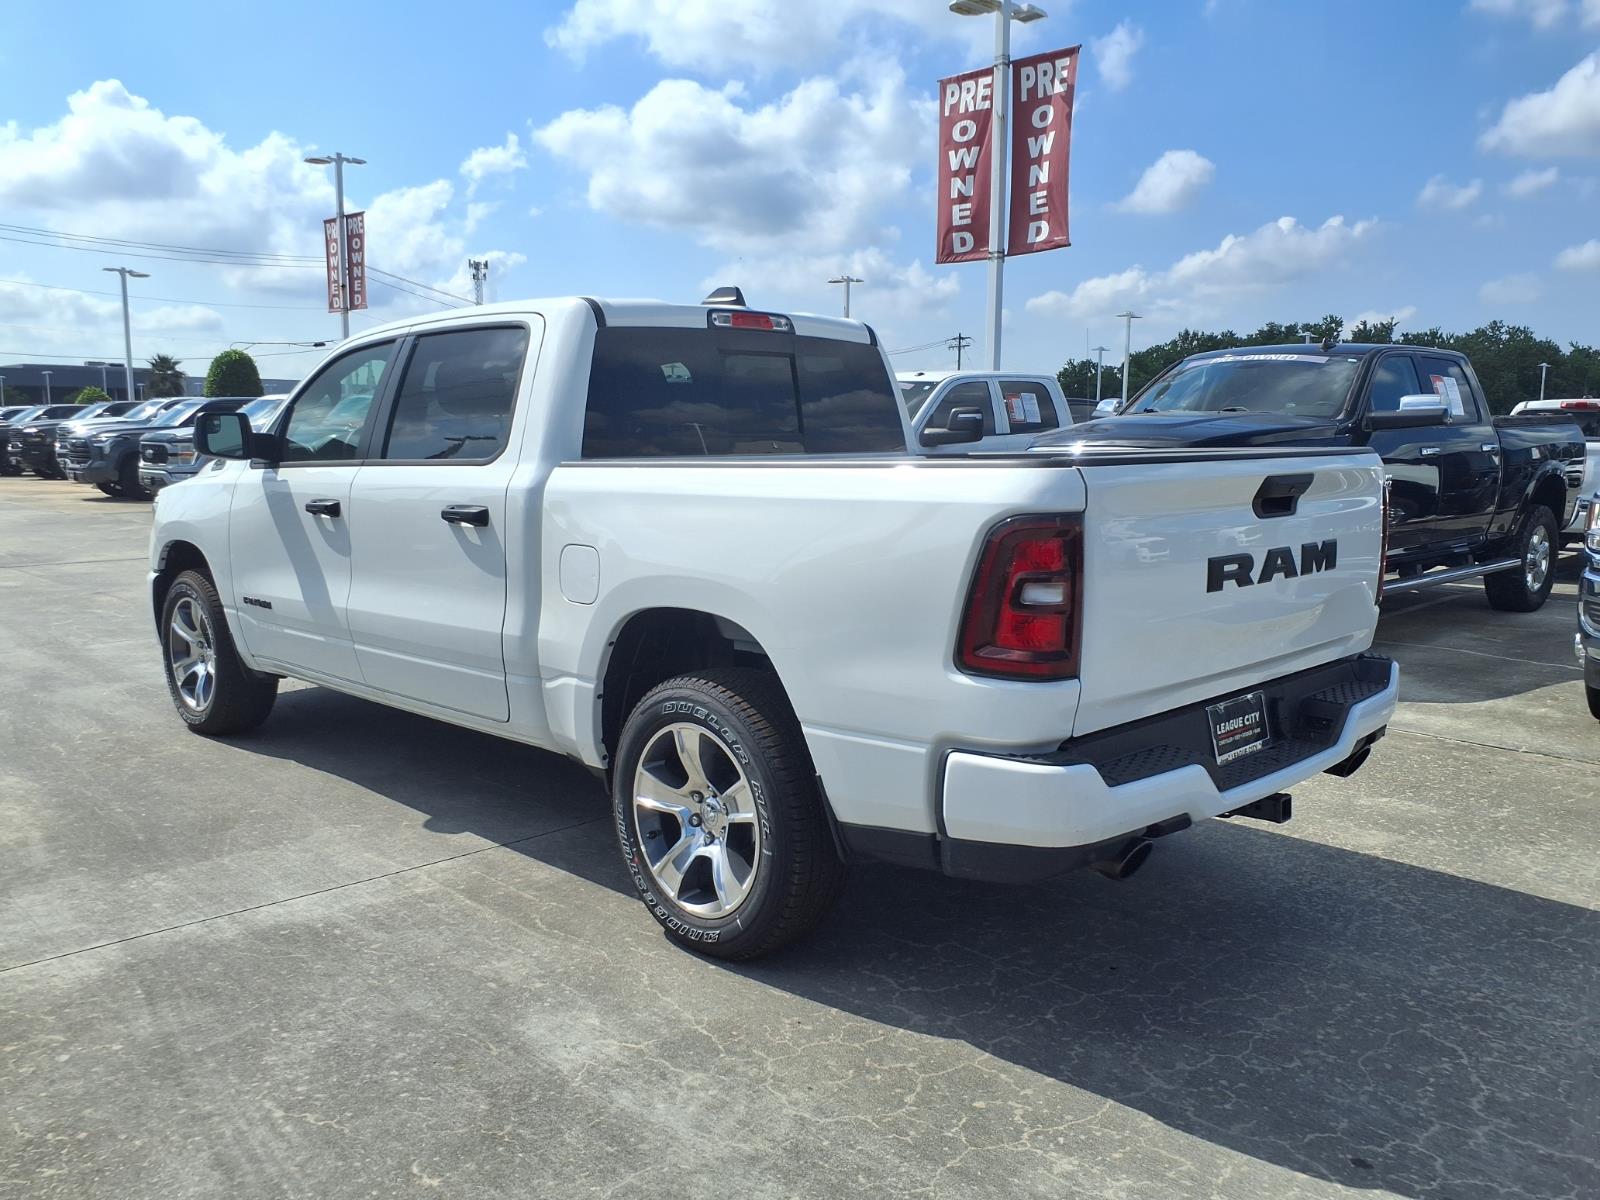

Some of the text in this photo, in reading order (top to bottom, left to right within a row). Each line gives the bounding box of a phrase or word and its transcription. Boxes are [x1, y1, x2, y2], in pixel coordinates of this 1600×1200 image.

[944, 75, 993, 117] PRE
[1020, 57, 1070, 102] PRE
[948, 119, 980, 254] OWNED
[1027, 104, 1056, 244] OWNED
[326, 222, 337, 239] PR
[348, 216, 364, 235] PRE
[330, 242, 340, 308] OWNED
[351, 238, 363, 305] OWNED
[1206, 538, 1338, 593] RAM
[661, 701, 749, 764] DUELER
[1216, 711, 1260, 735] LEAGUE CITY
